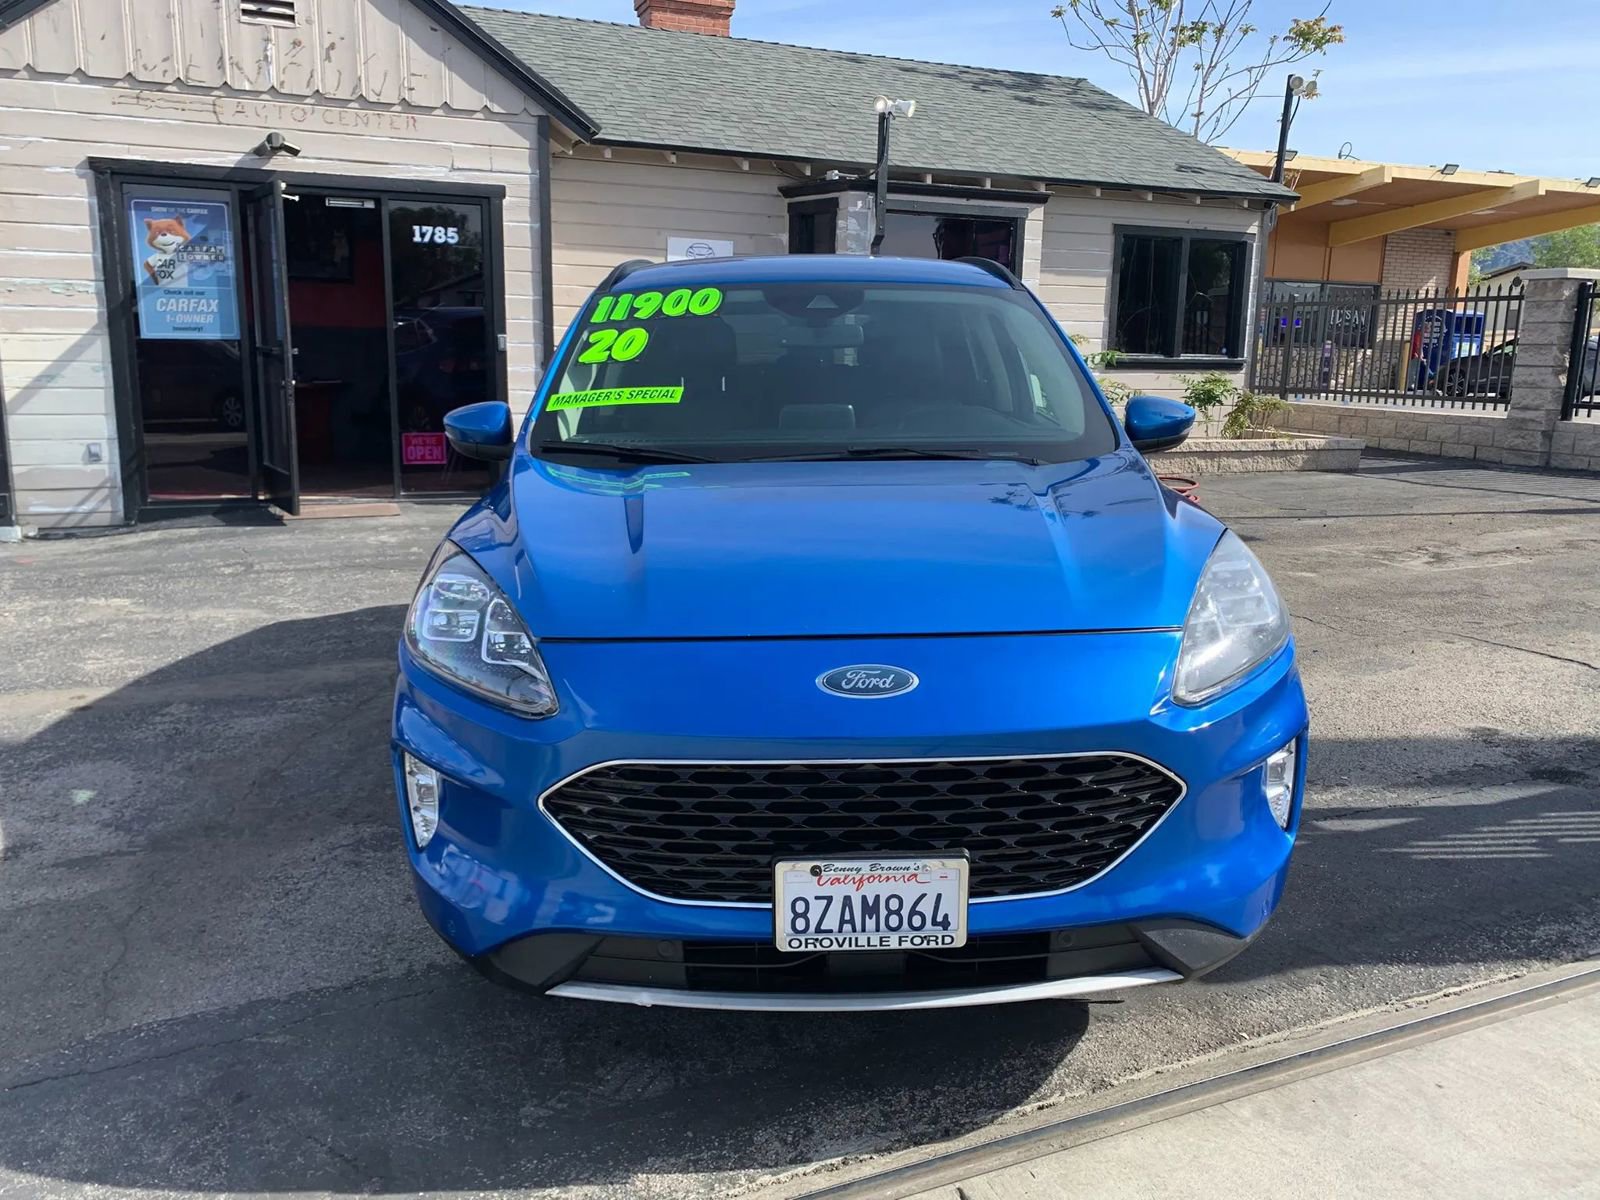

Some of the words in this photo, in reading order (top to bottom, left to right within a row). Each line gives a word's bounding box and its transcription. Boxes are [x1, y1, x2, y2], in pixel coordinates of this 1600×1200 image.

[412, 225, 459, 244] 1785
[156, 297, 220, 313] CARFAX
[589, 287, 723, 323] 11900
[166, 314, 215, 324] 1-OWNER
[578, 327, 649, 364] 20
[551, 391, 624, 407] MANAGER'S
[626, 389, 677, 400] SPECIAL
[407, 446, 443, 460] OPEN
[841, 669, 895, 689] Ford
[822, 863, 863, 875] Benny
[869, 861, 921, 873] Brown's
[816, 872, 931, 892] California
[790, 892, 952, 935] 8ZAM864
[787, 935, 892, 950] OROVILLE
[897, 933, 956, 948] FORD
